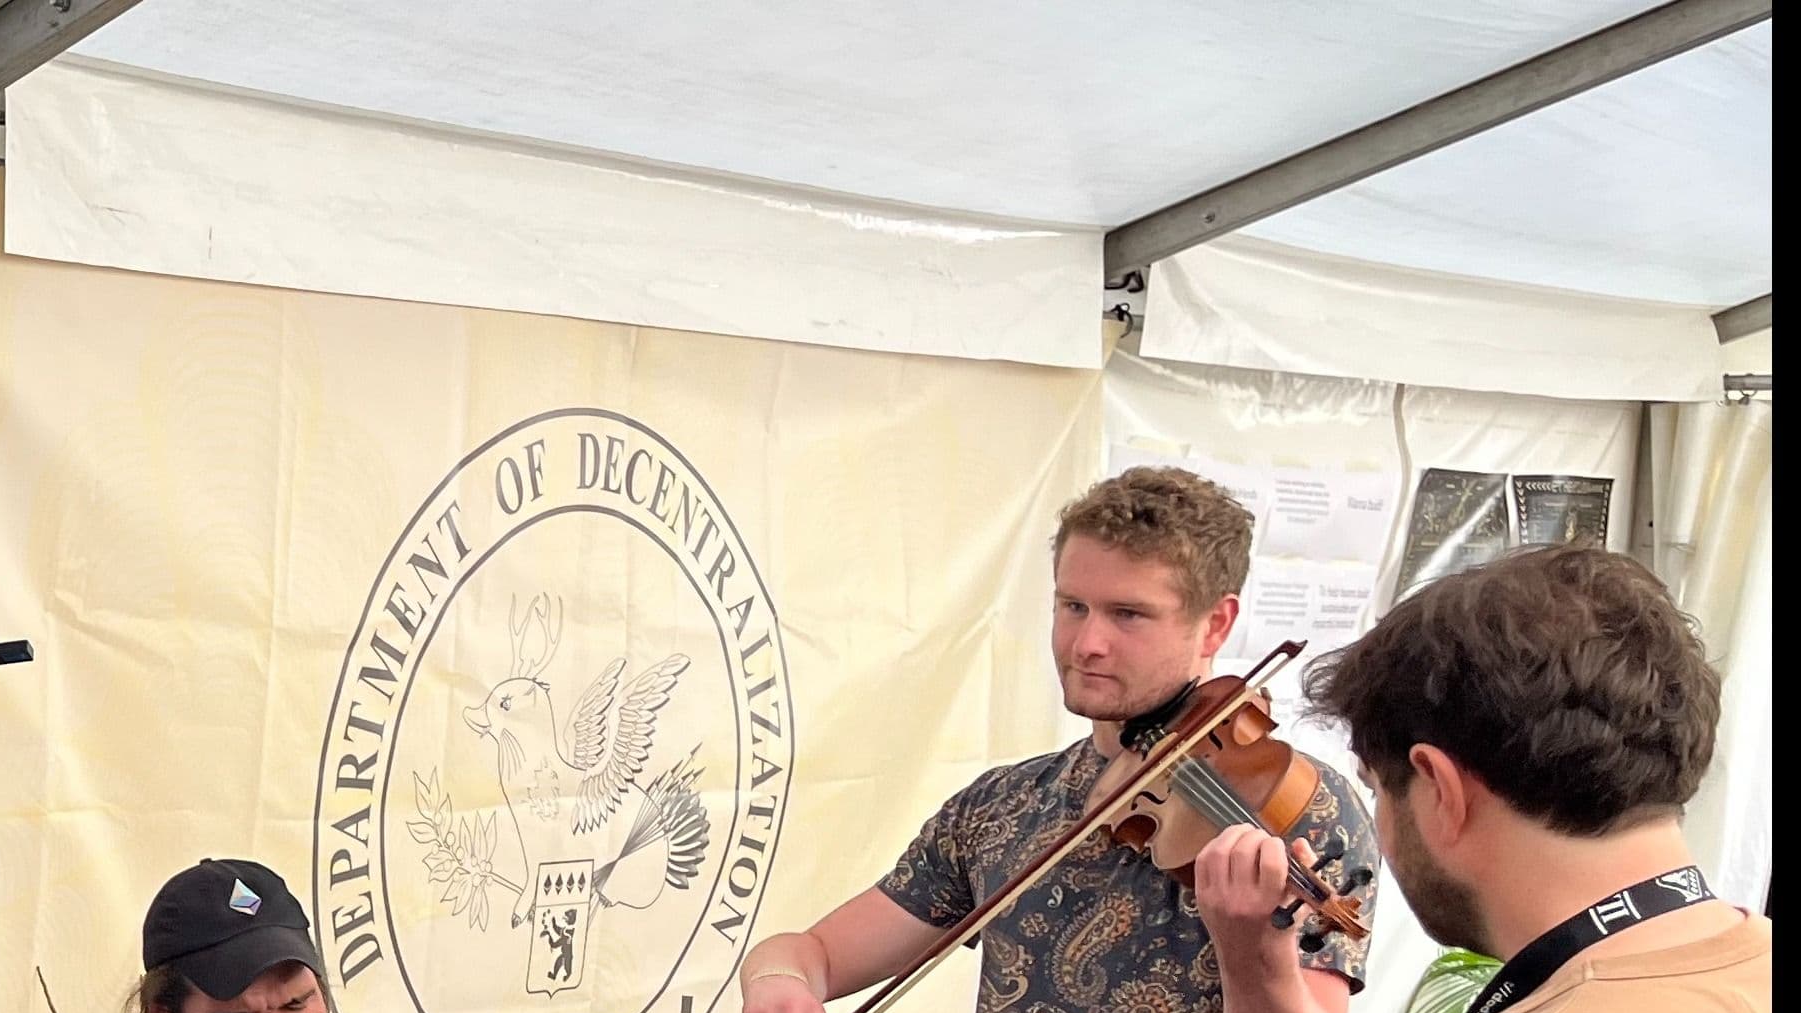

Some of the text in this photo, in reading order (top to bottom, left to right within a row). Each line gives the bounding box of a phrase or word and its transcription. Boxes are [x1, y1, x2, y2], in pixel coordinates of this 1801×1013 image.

[329, 431, 784, 988] DEPARTMENT OF DECENTRALIZATION
